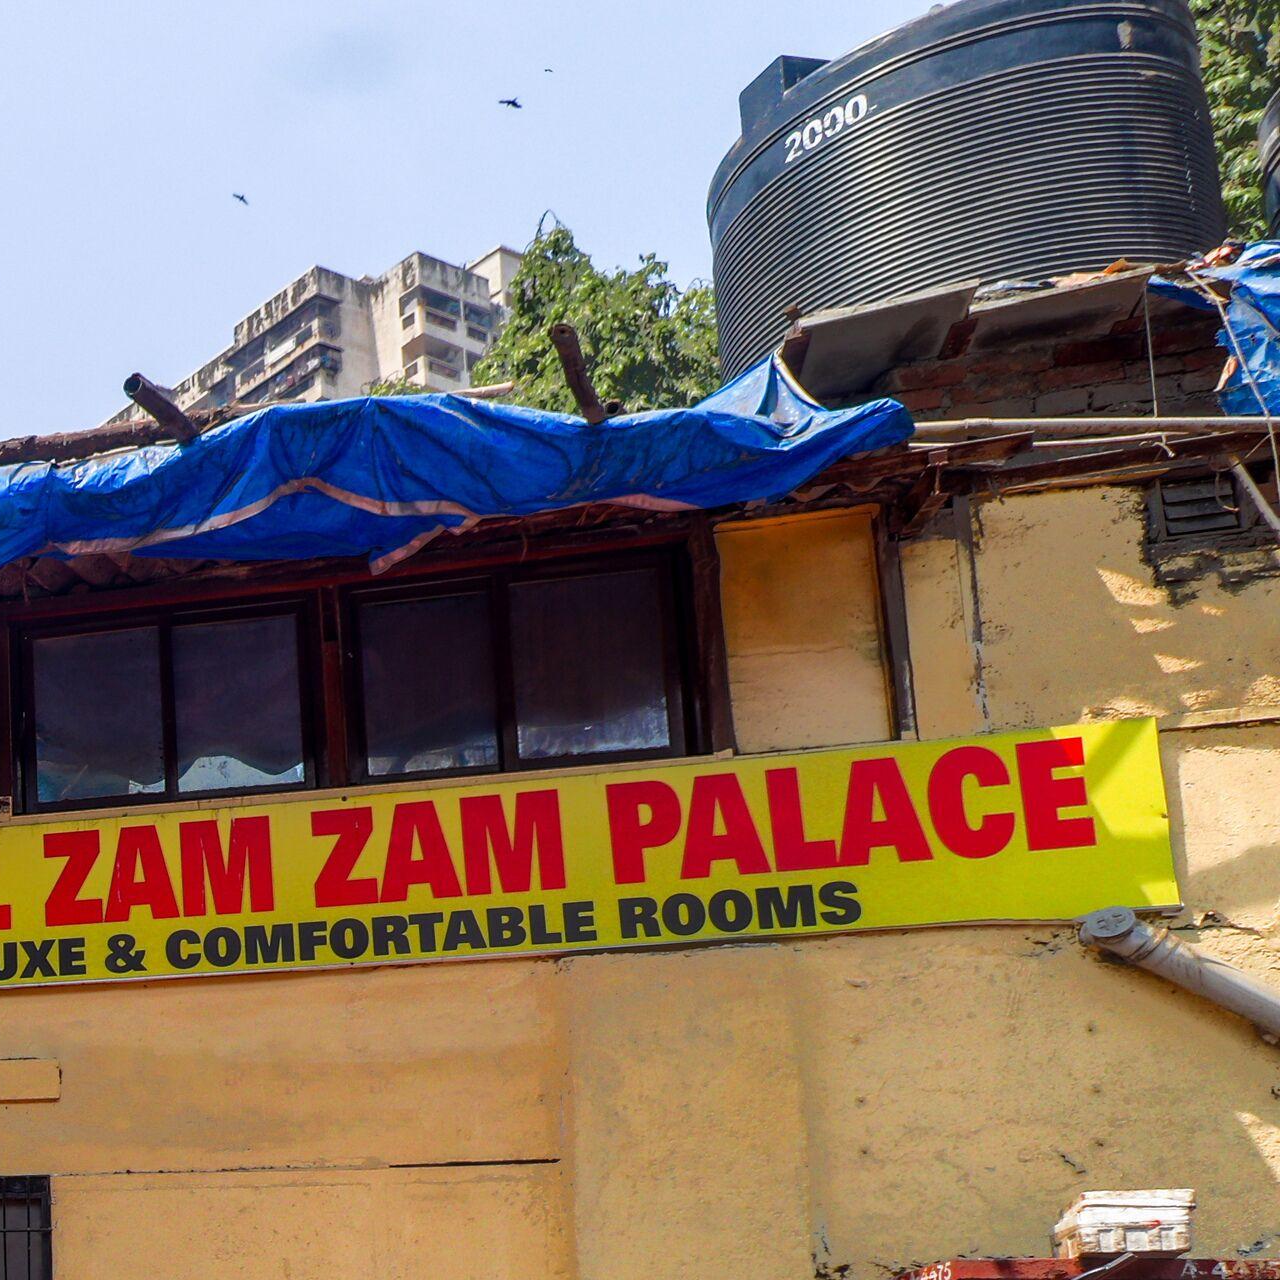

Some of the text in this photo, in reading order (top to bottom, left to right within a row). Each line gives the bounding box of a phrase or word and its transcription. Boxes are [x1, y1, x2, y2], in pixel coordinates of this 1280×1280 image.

[784, 93, 868, 164] 2000
[43, 815, 275, 927] ZAM
[311, 788, 568, 908] ZAM
[605, 736, 1097, 886] PALACE
[104, 933, 147, 974] &
[165, 899, 599, 970] COMFORTABLE
[618, 880, 863, 940] ROOMS
